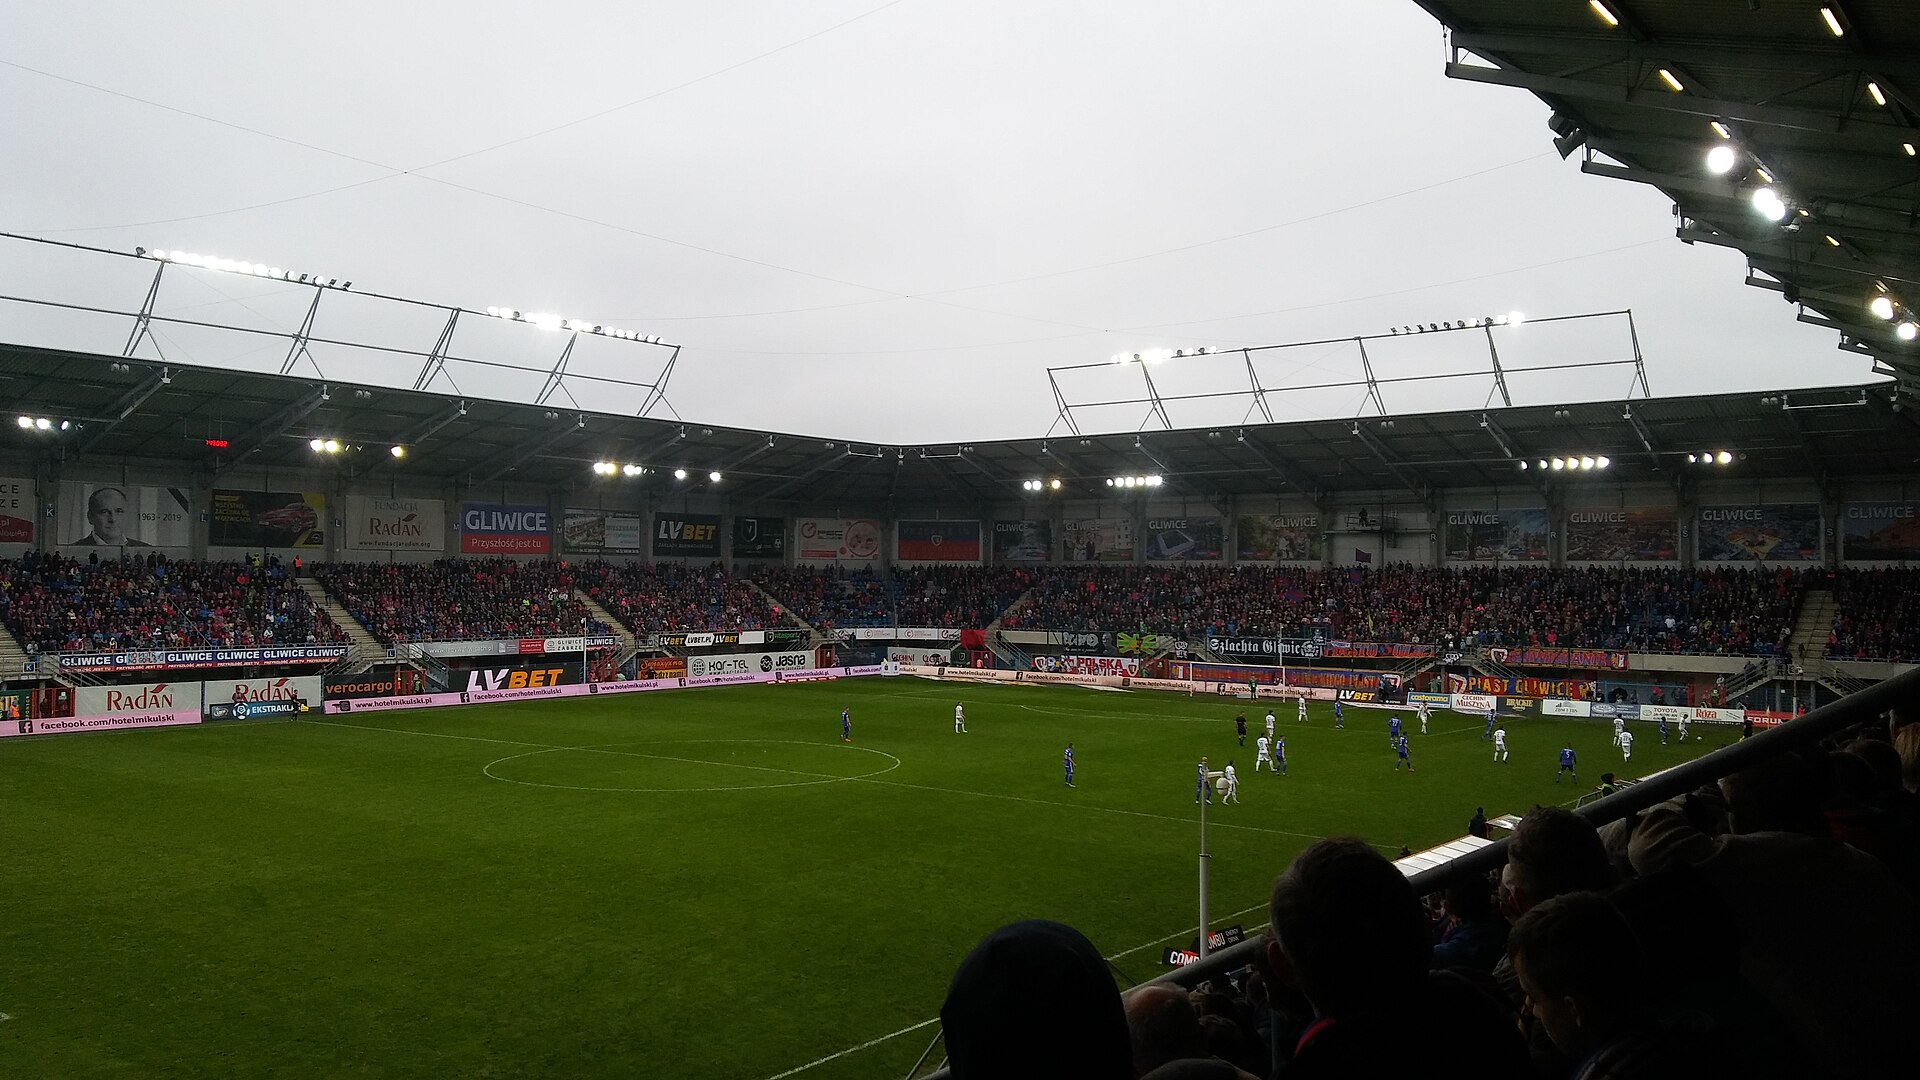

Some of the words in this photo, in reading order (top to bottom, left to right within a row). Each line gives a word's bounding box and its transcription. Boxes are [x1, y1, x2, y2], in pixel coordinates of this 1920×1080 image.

[374, 501, 418, 512] FUNDACJA
[46, 508, 54, 517] K
[137, 513, 156, 522] 1963
[162, 513, 181, 522] 2019
[1570, 512, 1626, 523] GLIWICE
[1703, 509, 1763, 521] GLIWICE
[1848, 506, 1915, 519] GLIWICE
[465, 511, 547, 532] GLIWICE
[1149, 519, 1187, 530] GLIWICE
[1274, 517, 1316, 528] GLIWICE
[1449, 515, 1499, 525] GLIWICE
[658, 520, 717, 541] LVBET
[532, 540, 541, 548] tu
[585, 637, 614, 646] GLIWICE
[687, 634, 713, 644] LVBET.PL
[1210, 638, 1259, 655] Szlachta
[168, 652, 213, 662] GLIWICE
[217, 650, 260, 660] GLIWICE
[263, 649, 305, 659] GLIWICE
[307, 648, 346, 657] GLIWICE
[62, 656, 111, 667] GLIWICE
[1077, 657, 1123, 669] POLSKA
[852, 667, 881, 675] facebook.com/
[947, 669, 997, 677] www.hotelmikulski.pl
[466, 668, 564, 692] LVBET
[1026, 674, 1097, 683] facebook.com/hotelmikulski
[326, 681, 393, 694] verocargo
[601, 681, 659, 691] www.hotelmikulski.pl
[1469, 677, 1508, 694] PIAST
[474, 688, 562, 700] facebook.com/hotelmikulski
[1339, 690, 1375, 701] LVBET
[1411, 694, 1448, 703] castorama
[355, 697, 433, 709] www.hotelmikulski.pl
[40, 715, 175, 730] facebook.com/hotelmikulski
